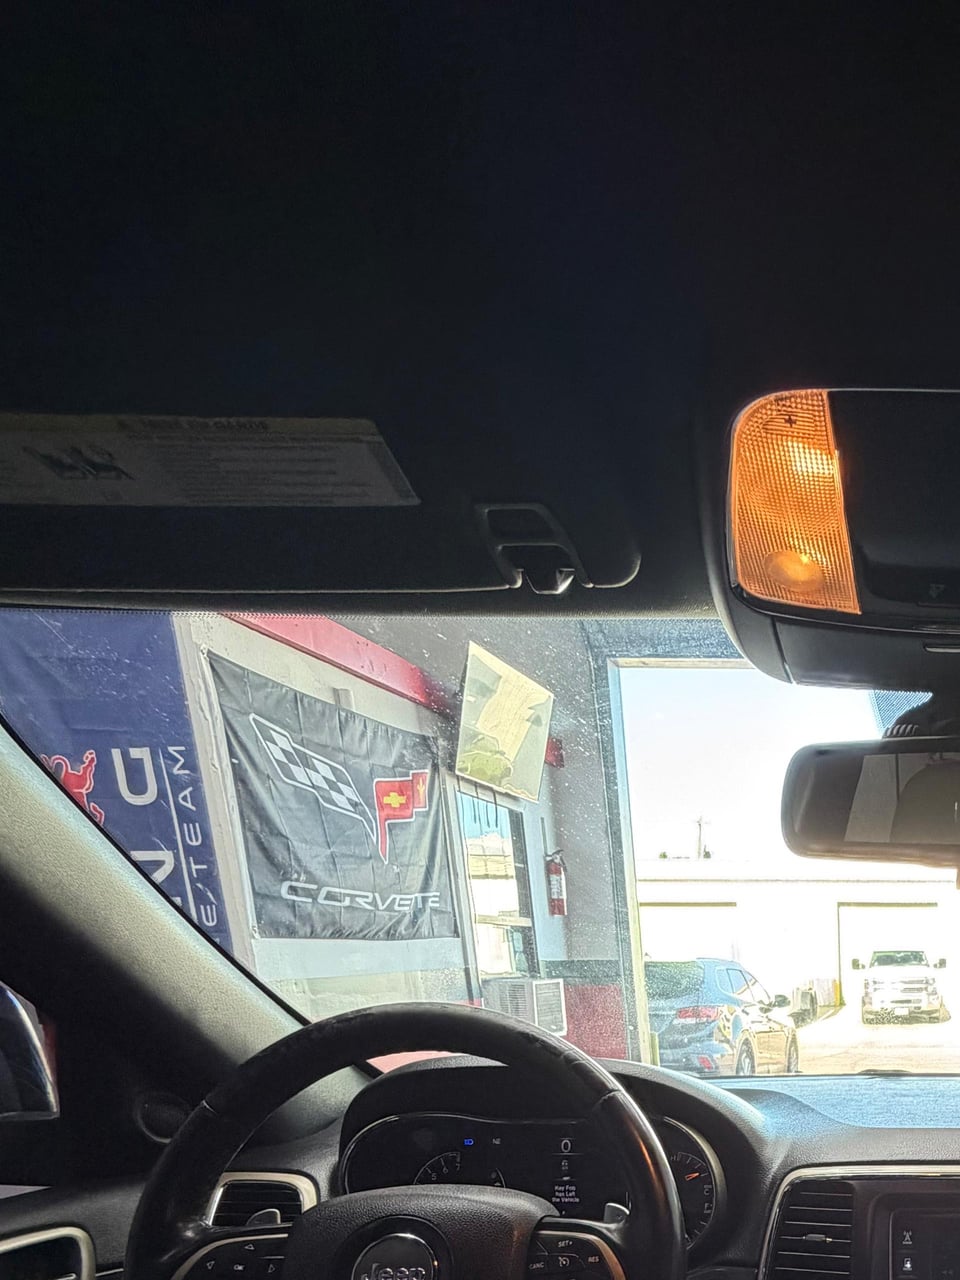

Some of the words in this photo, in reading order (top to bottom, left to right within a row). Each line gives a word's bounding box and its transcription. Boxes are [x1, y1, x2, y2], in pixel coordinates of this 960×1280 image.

[167, 745, 208, 878] TEAM
[561, 1139, 572, 1153] 0
[431, 1173, 438, 1181] 5
[557, 1240, 573, 1248] SET+
[587, 1255, 601, 1263] RES
[528, 1261, 545, 1270] CANC
